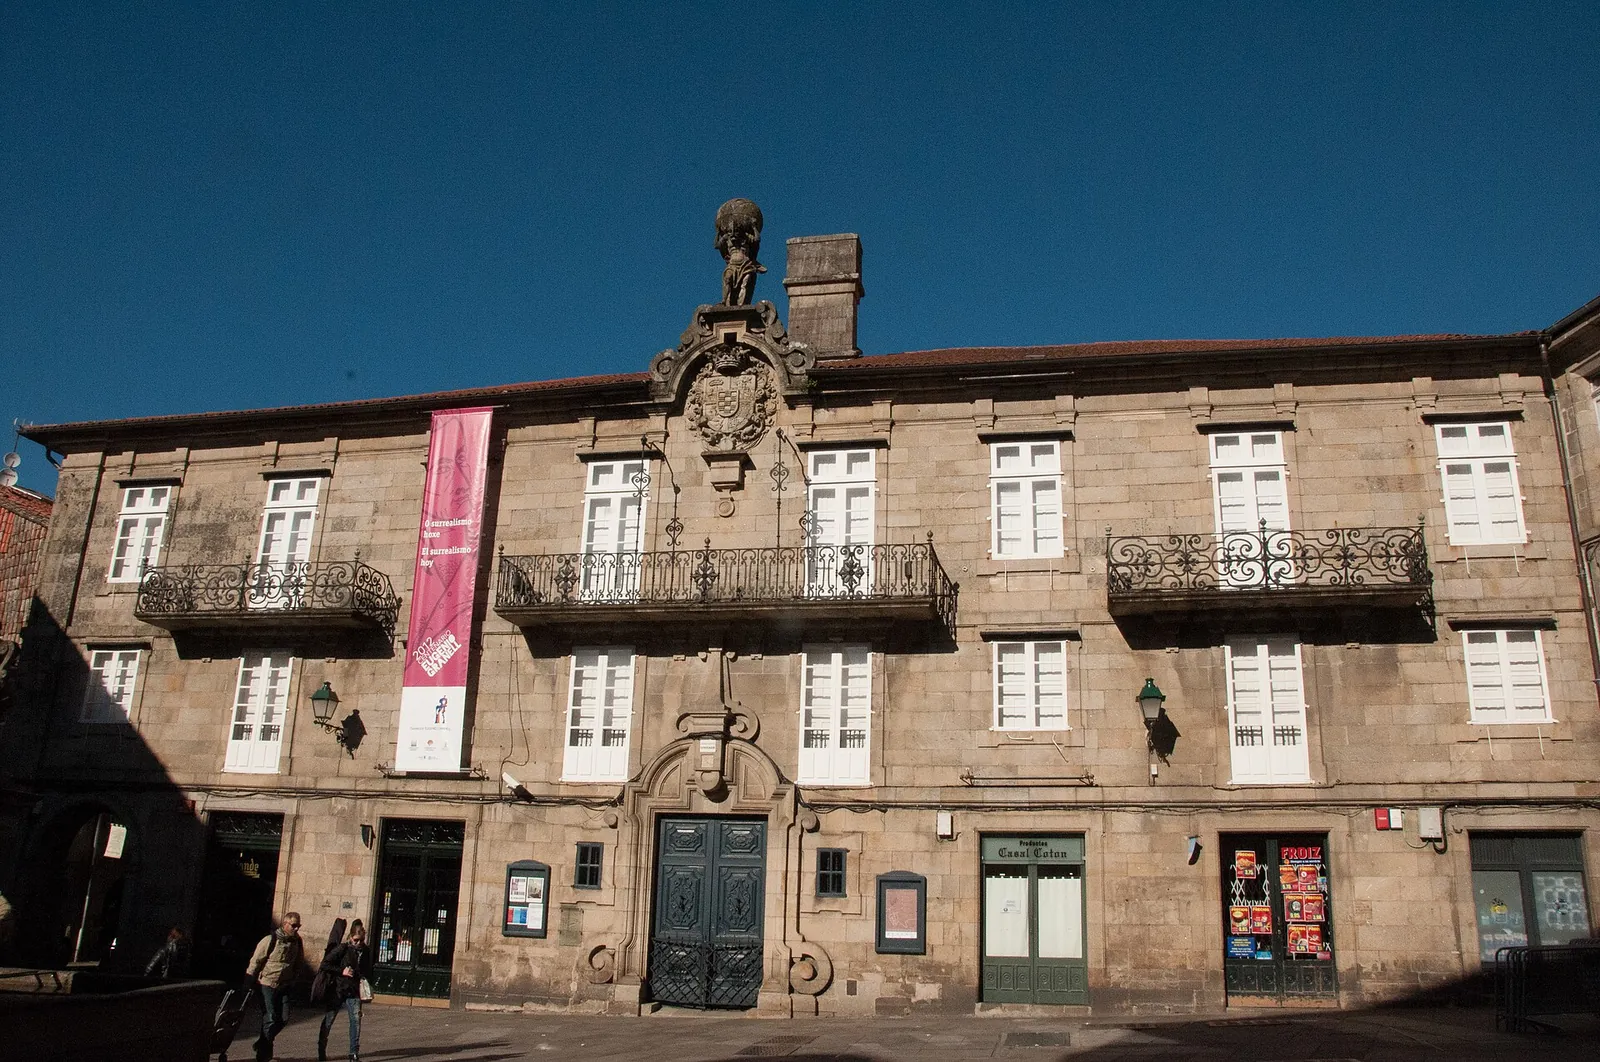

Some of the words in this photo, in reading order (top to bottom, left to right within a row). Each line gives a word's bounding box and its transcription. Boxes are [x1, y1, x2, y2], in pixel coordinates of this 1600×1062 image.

[425, 520, 430, 528] O
[431, 518, 472, 527] surrealismo
[423, 530, 441, 538] hoxe
[421, 547, 429, 556] El
[430, 546, 472, 556] surrealismo
[420, 558, 434, 568] hoy
[412, 636, 434, 661] 2012
[420, 633, 456, 672] EUGENIO
[427, 641, 462, 677] GRANELL
[998, 847, 1029, 858] Casal
[1033, 847, 1067, 858] Coton
[1281, 847, 1322, 860] FROIZ
